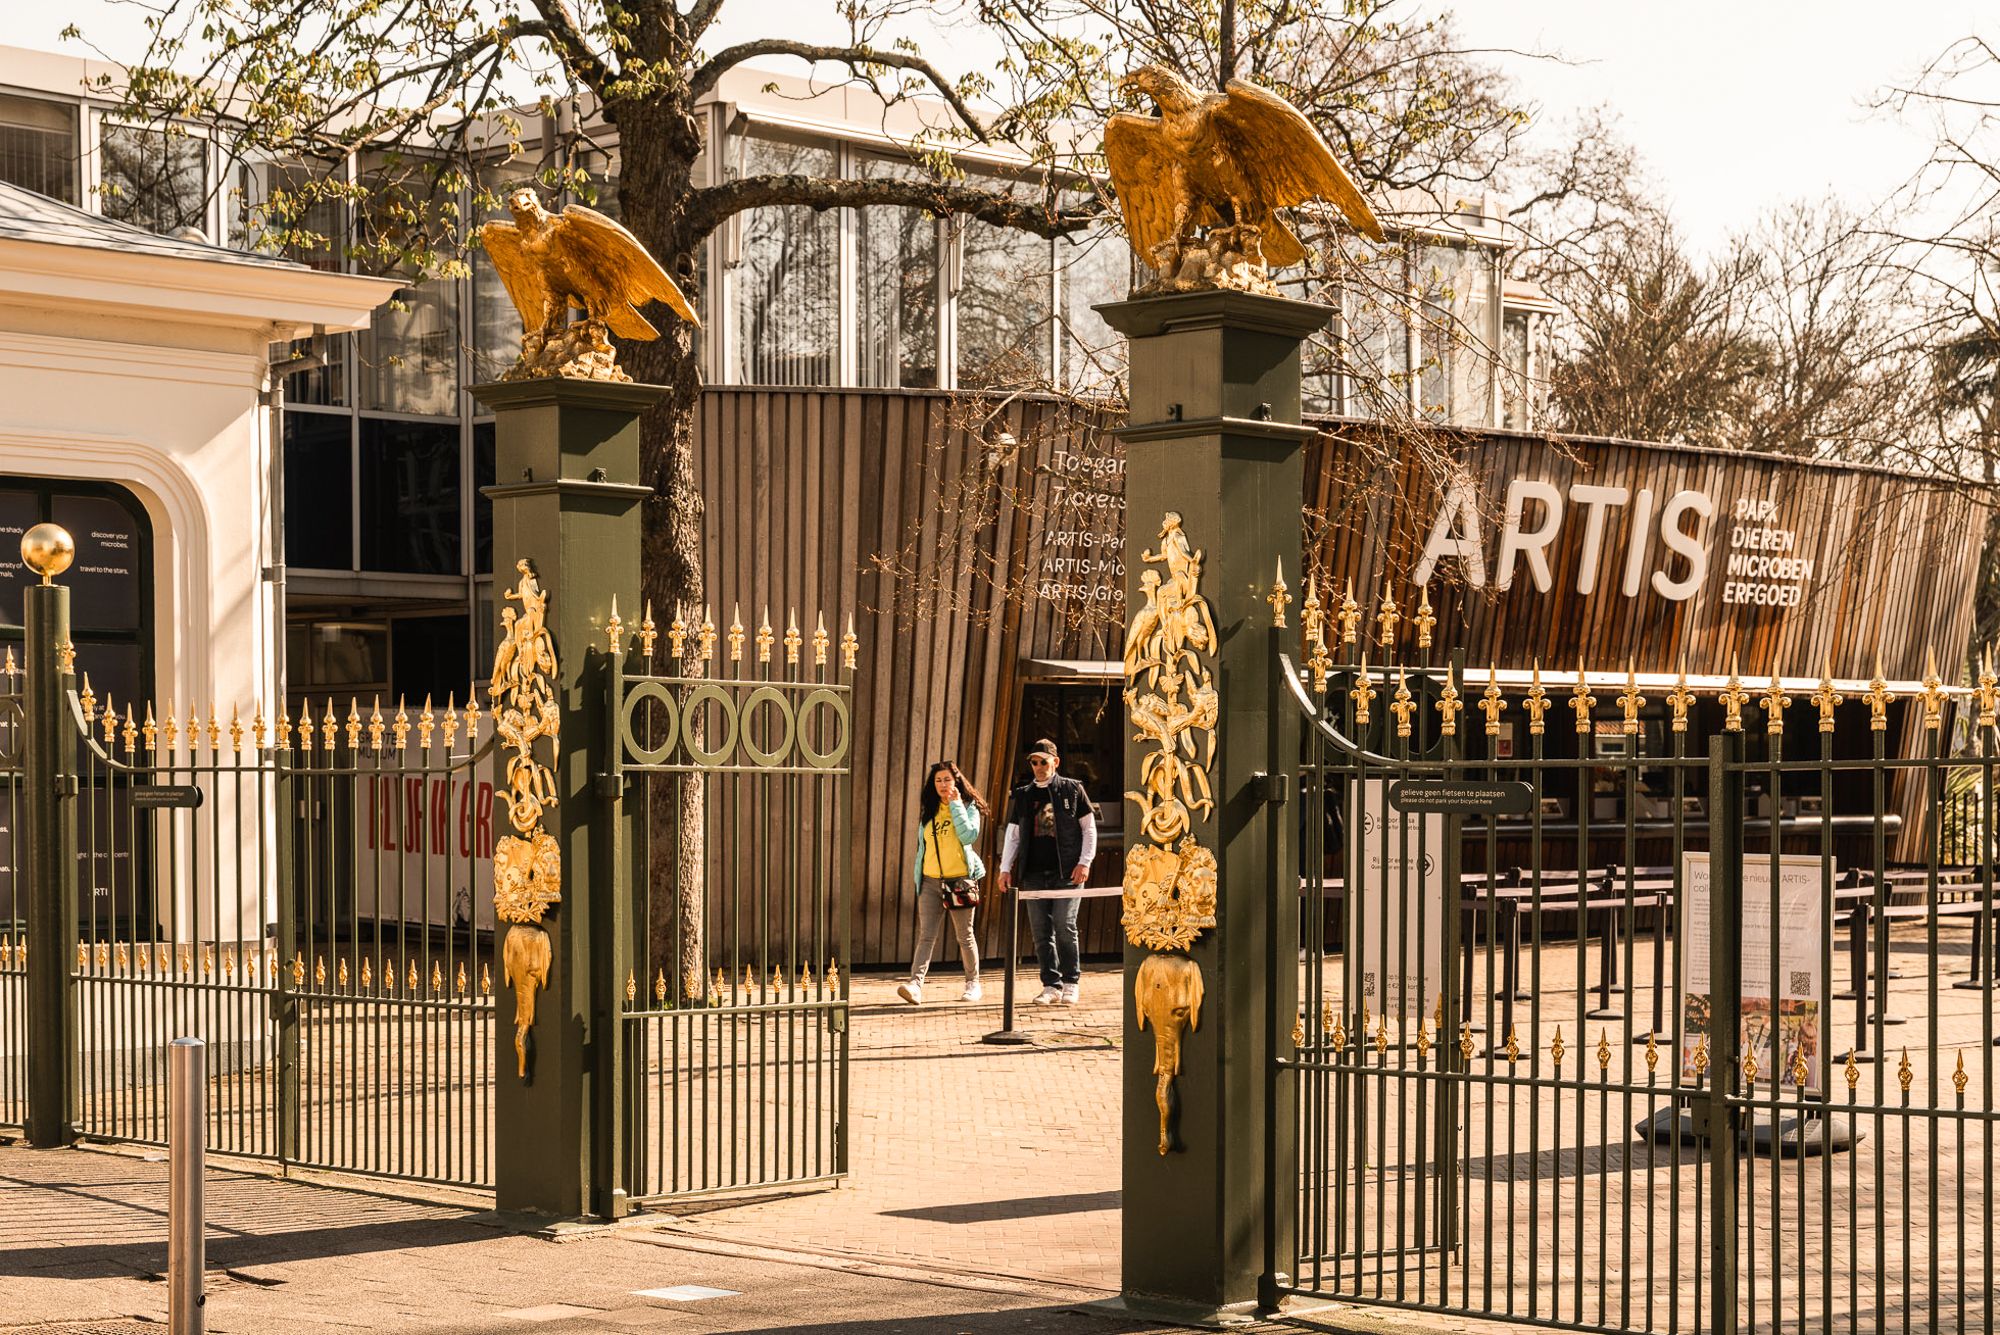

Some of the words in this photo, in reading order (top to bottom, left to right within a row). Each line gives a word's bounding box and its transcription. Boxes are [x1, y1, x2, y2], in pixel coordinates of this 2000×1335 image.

[1736, 498, 1779, 522] PARK
[1412, 472, 1712, 601] ARTIS
[1731, 526, 1795, 552] DIEREN
[1727, 554, 1815, 580] MICROBEN
[1722, 582, 1801, 606] ERFGOED
[1400, 789, 1423, 797] gelieve
[1782, 874, 1811, 884] ARTIS-
